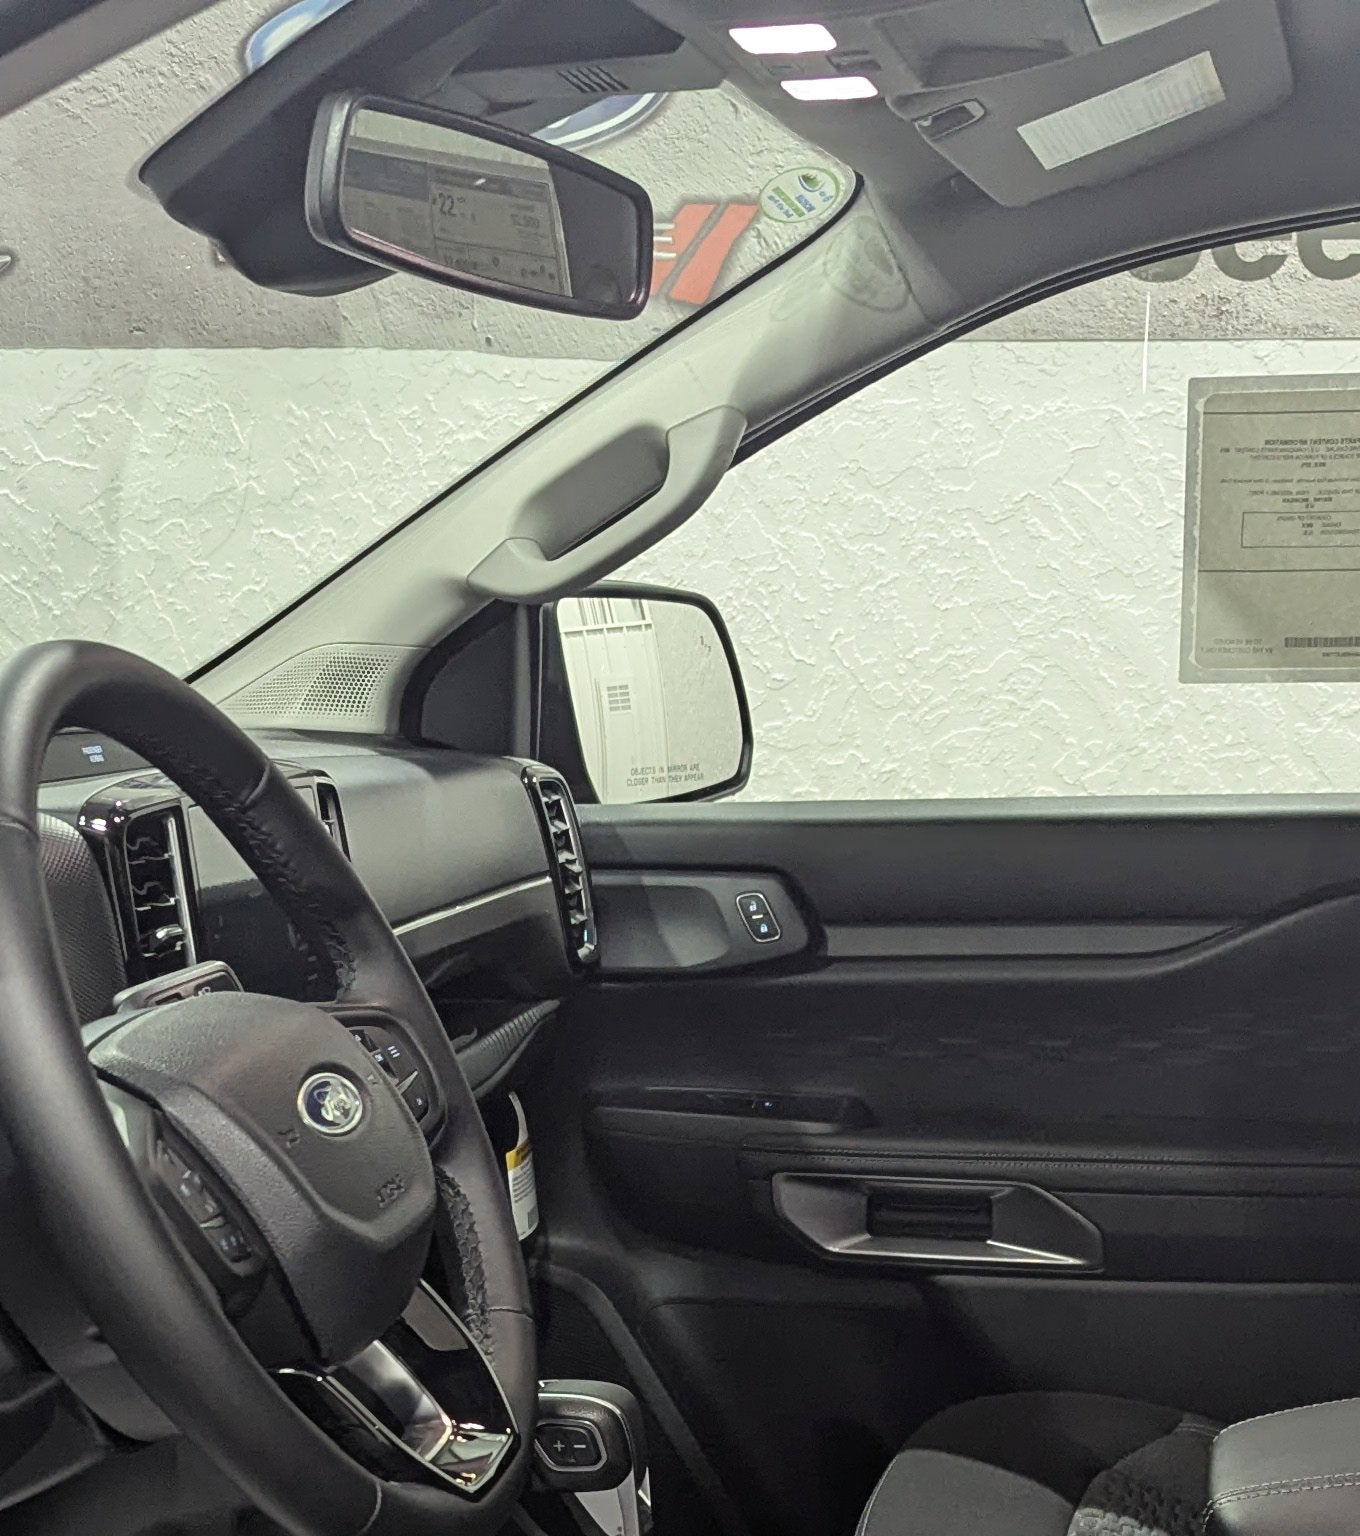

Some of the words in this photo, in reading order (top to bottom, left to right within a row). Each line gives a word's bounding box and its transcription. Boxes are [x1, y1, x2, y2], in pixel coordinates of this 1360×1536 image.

[630, 766, 656, 776] OBJECTS
[658, 766, 665, 774] IN
[689, 763, 700, 772] ARE
[626, 777, 649, 787] CLOSER
[651, 776, 666, 784] THAN
[667, 774, 683, 783] THEY
[684, 773, 704, 782] APPEAR
